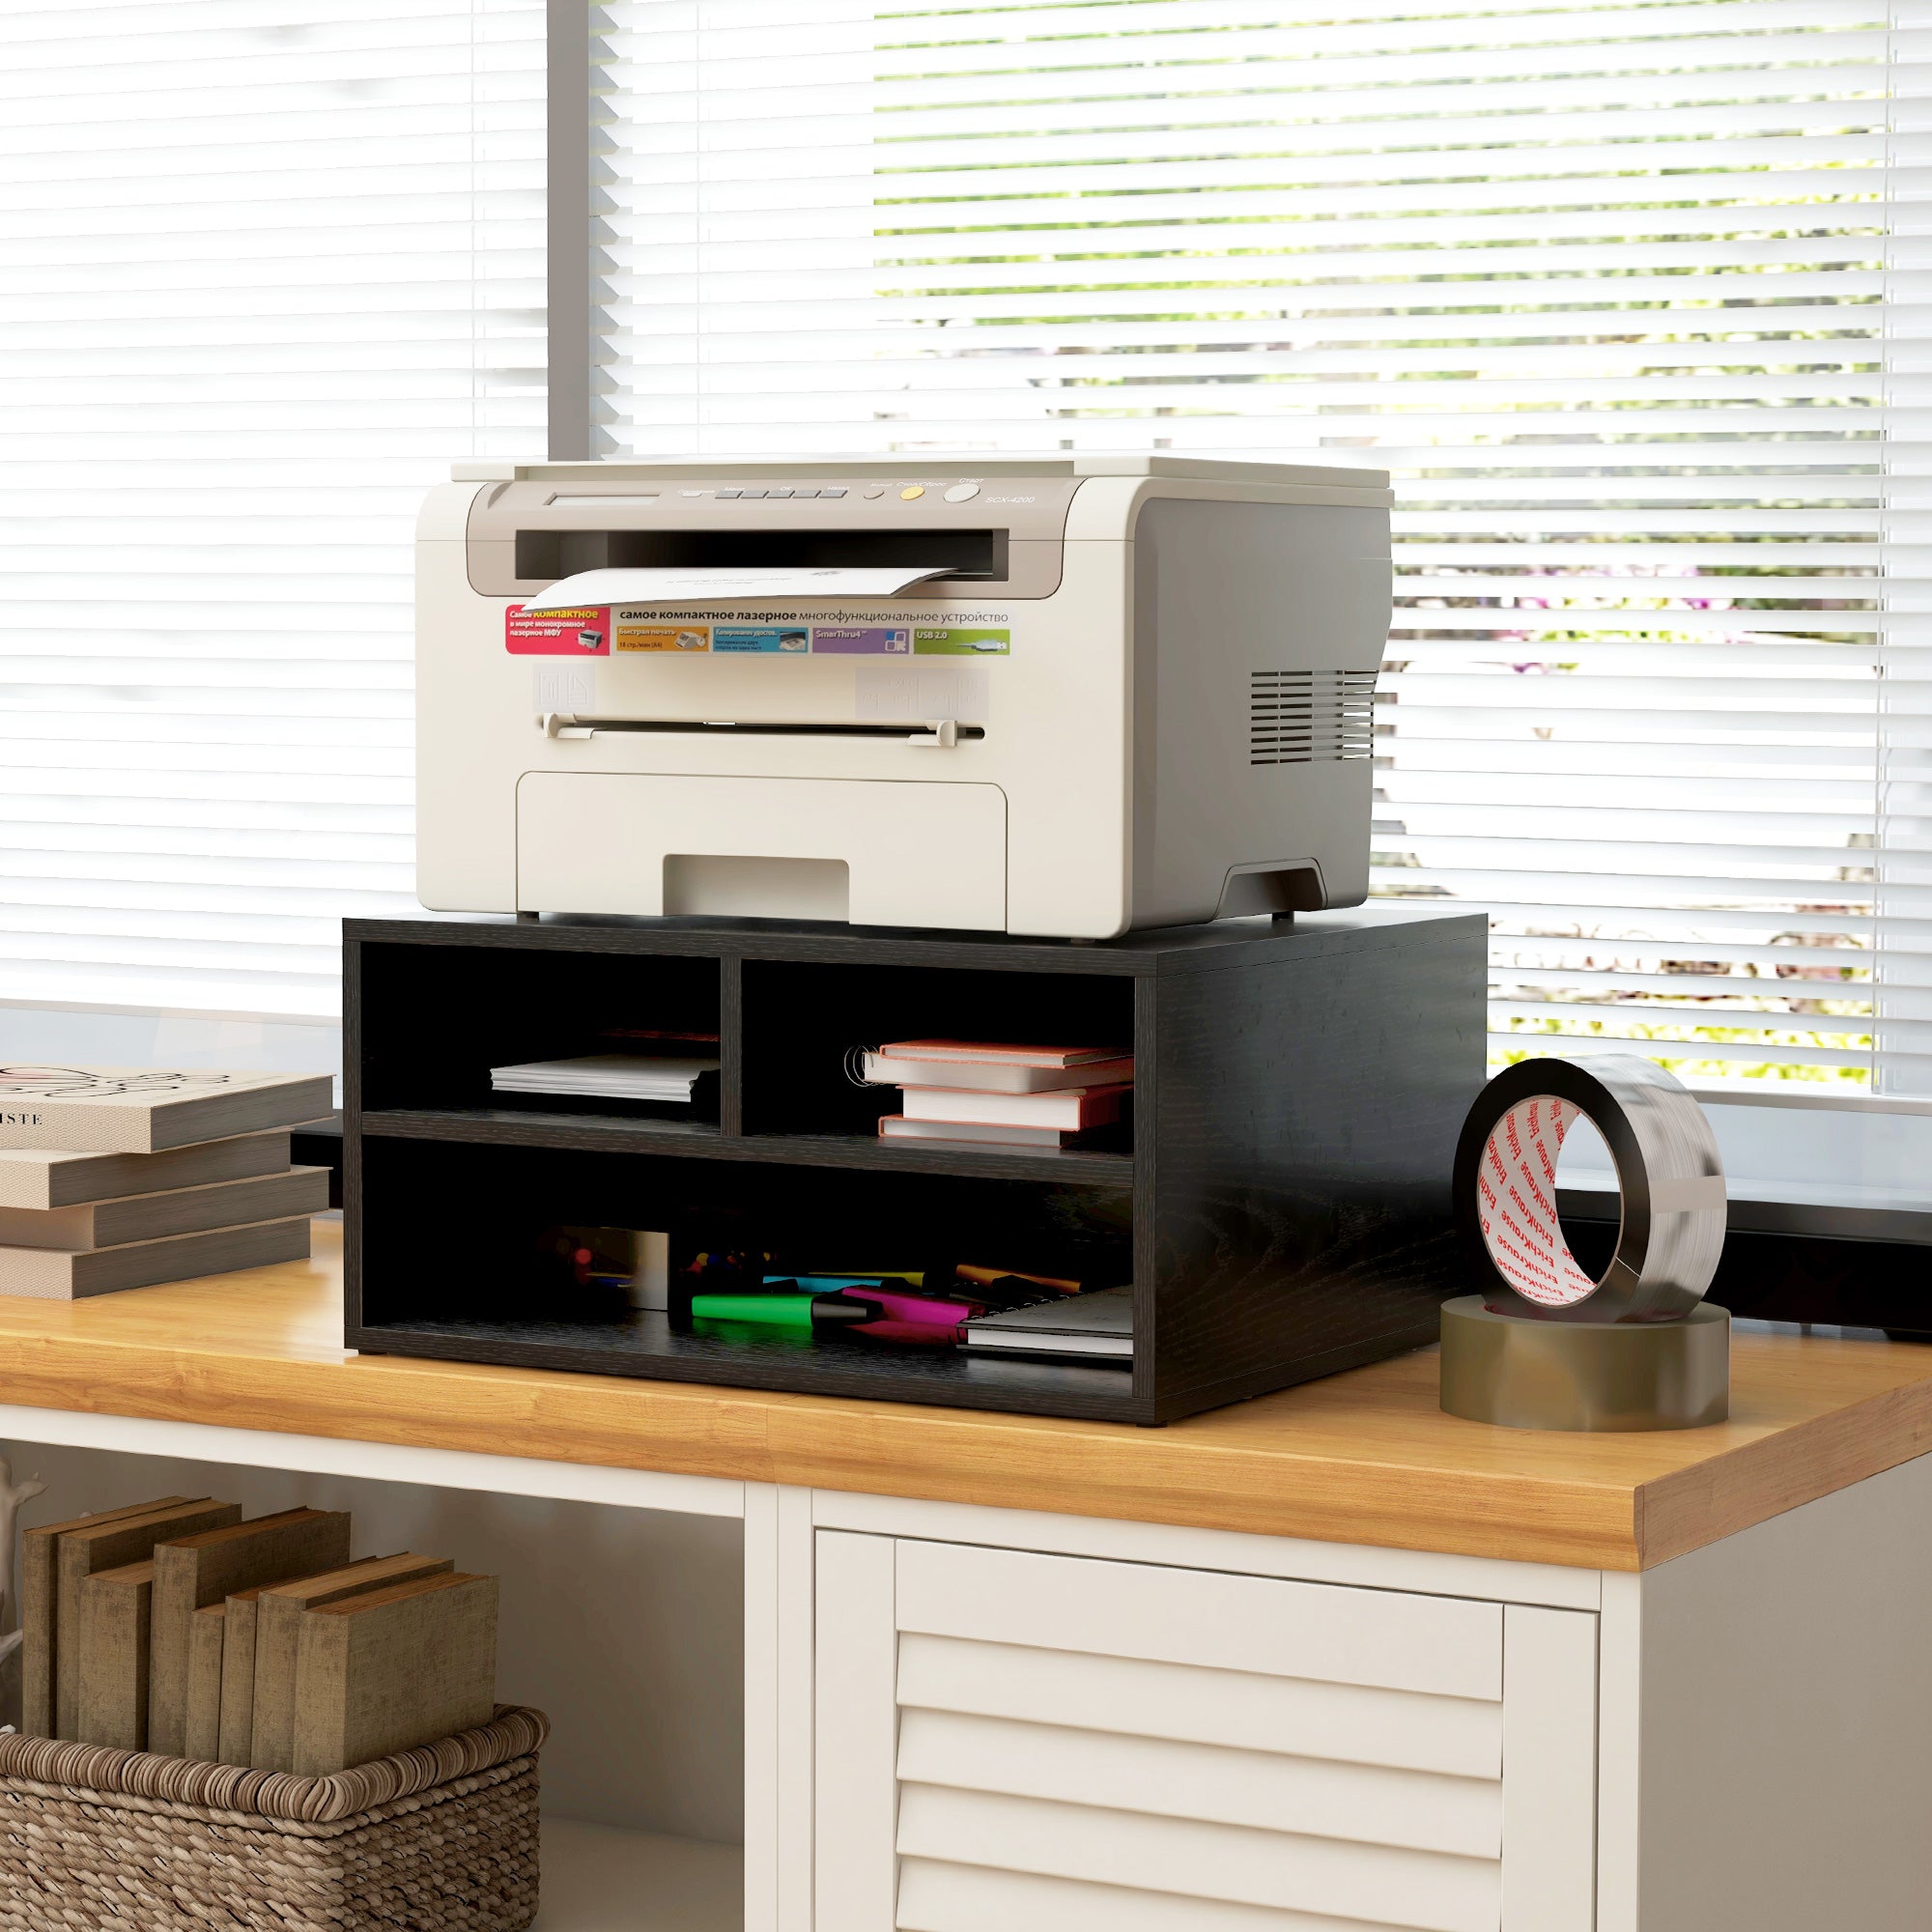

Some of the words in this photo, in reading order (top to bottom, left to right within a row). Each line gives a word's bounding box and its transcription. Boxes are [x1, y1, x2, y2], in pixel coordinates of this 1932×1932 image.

[509, 610, 533, 619] Самое
[533, 610, 598, 619] компактное
[509, 630, 547, 639] лазерное
[544, 629, 562, 638] МФУ
[515, 621, 534, 630] мире
[534, 621, 586, 630] монохромное
[619, 611, 657, 619] самое
[659, 611, 735, 620] компактное
[736, 611, 797, 623] лазерное
[799, 609, 939, 624] многофункциональное
[941, 611, 1009, 625] устройство
[1507, 1113, 1521, 1161] ErichKrause
[1520, 1161, 1556, 1225] ErichKrause
[1509, 1184, 1553, 1248] ErichKrause
[1496, 1235, 1558, 1285] ErichKrause
[1501, 1209, 1554, 1268] ErichKrause
[1496, 1257, 1564, 1296] ErichKrause
